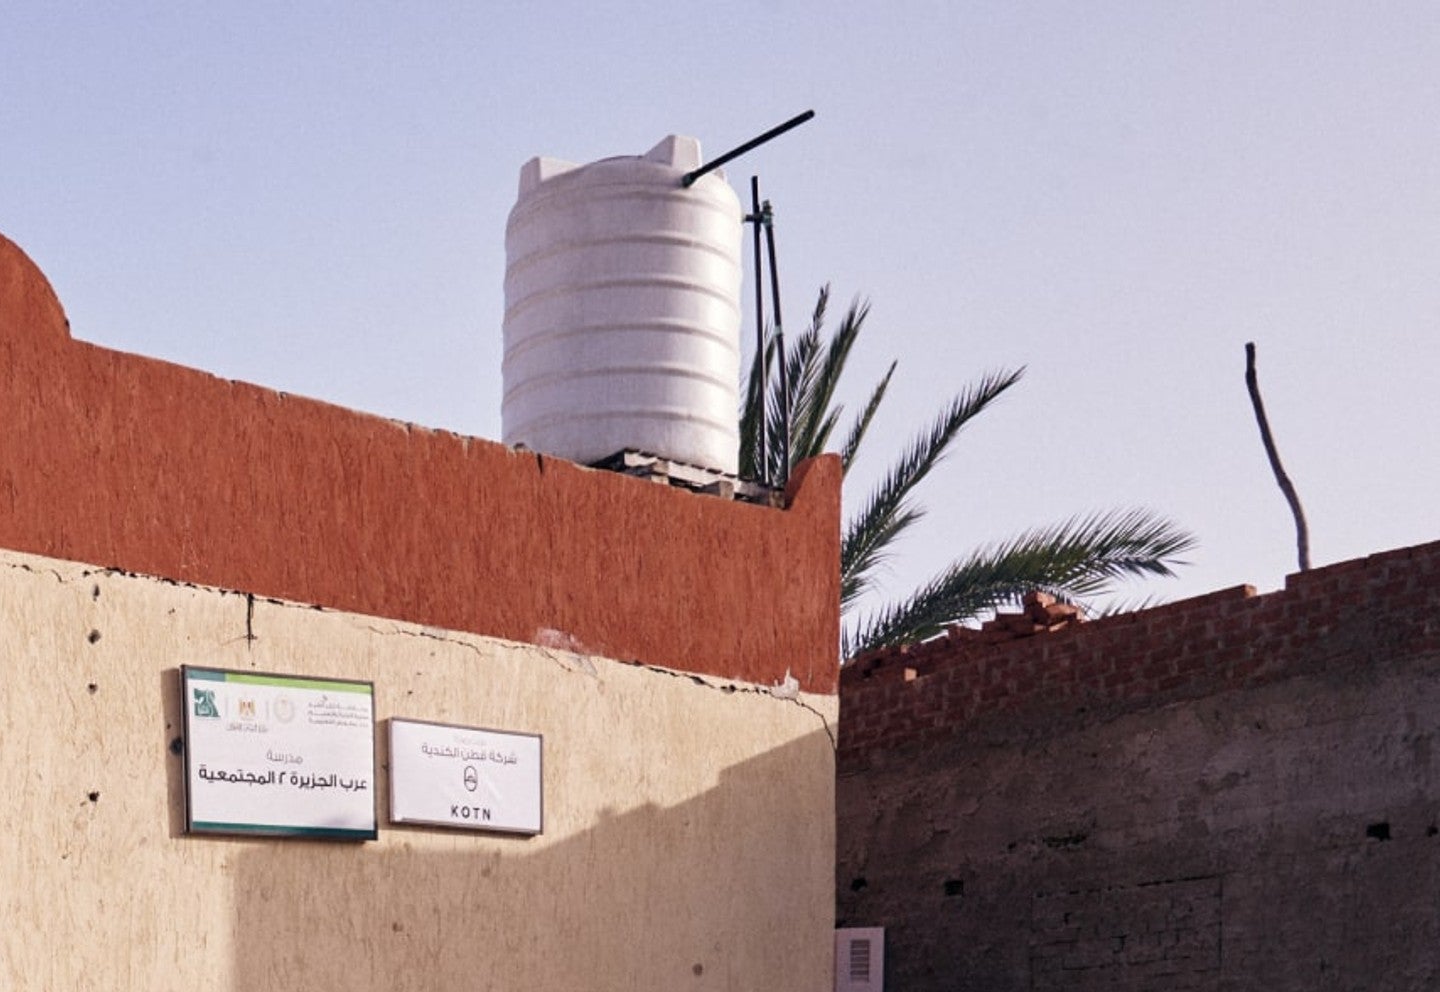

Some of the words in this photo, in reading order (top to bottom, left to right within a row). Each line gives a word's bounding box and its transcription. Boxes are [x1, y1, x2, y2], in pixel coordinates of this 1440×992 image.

[266, 749, 304, 765] مدرسة
[421, 742, 459, 758] الكندية
[461, 747, 487, 762] قطن
[489, 749, 518, 765] شركة
[198, 763, 275, 786] المجتمعية
[290, 770, 337, 789] الجزيرة
[341, 778, 368, 792] عرب
[450, 805, 491, 821] KOTN
